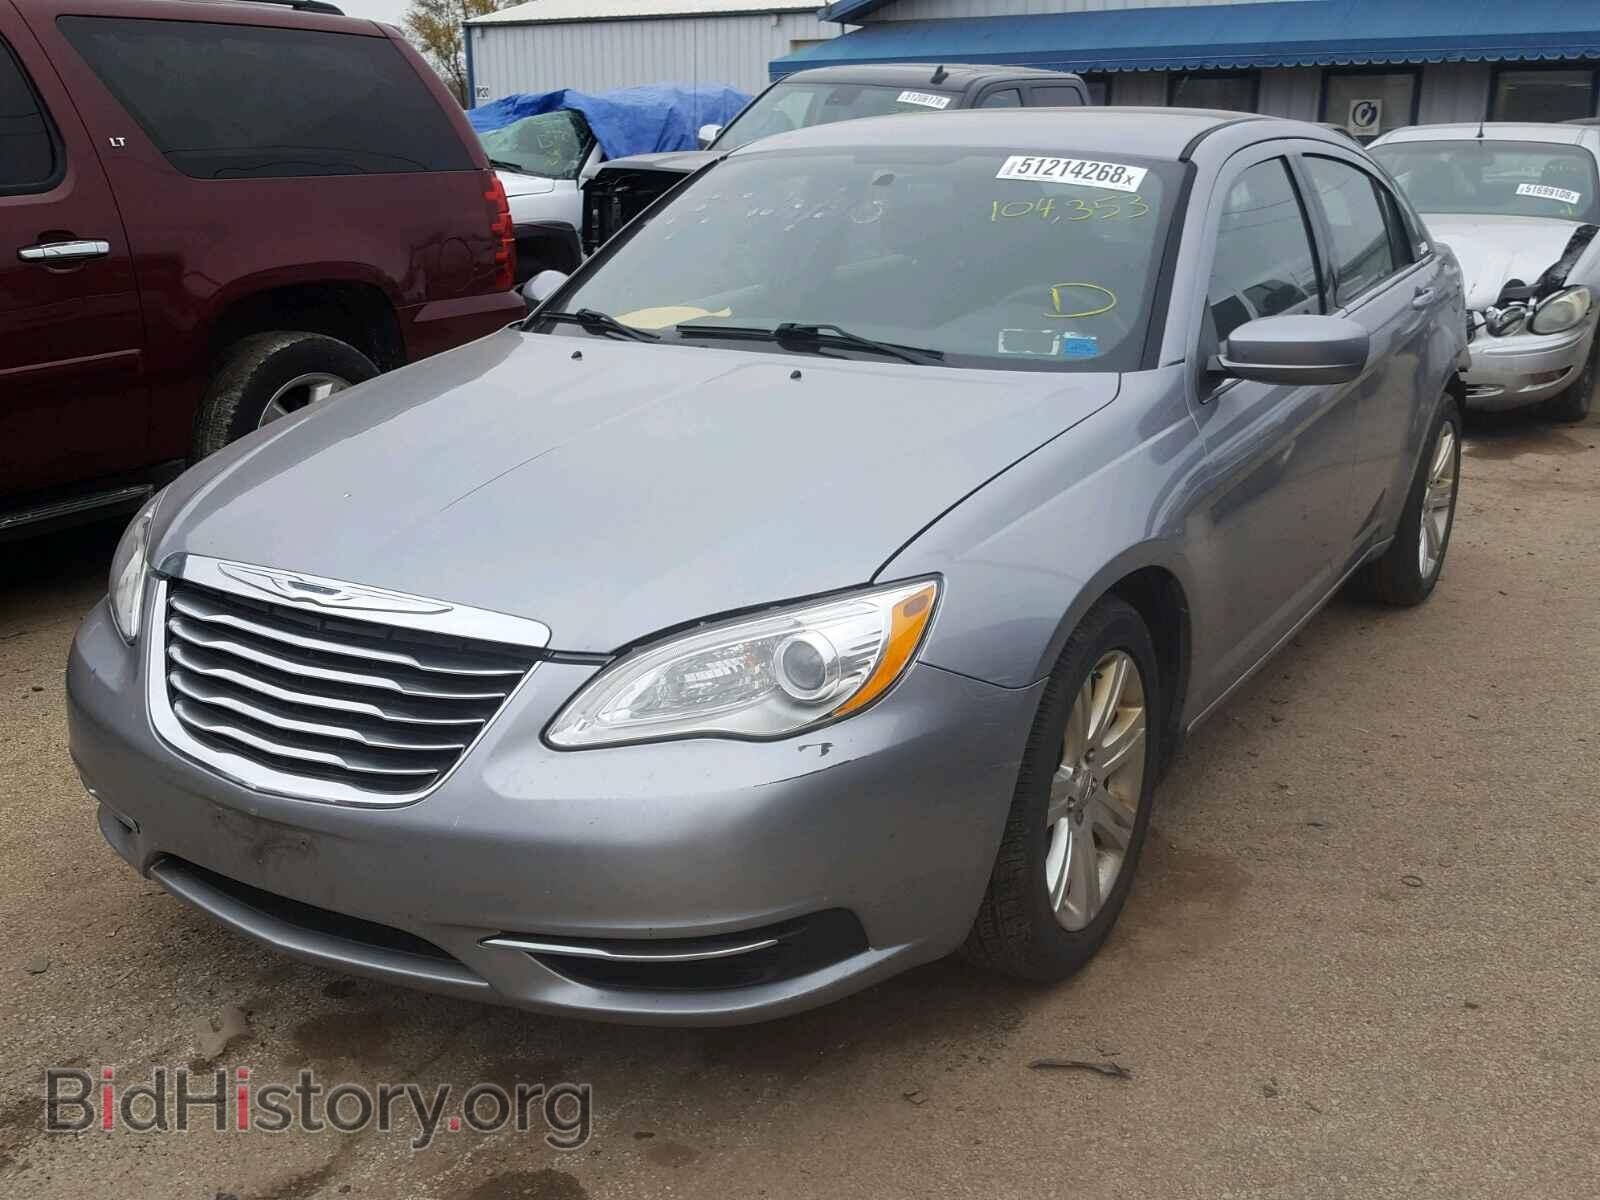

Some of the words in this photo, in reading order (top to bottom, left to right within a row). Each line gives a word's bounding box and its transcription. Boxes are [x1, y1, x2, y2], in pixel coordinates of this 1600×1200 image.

[108, 137, 126, 147] LT
[990, 194, 1150, 224] 104,353
[1042, 282, 1117, 318] D
